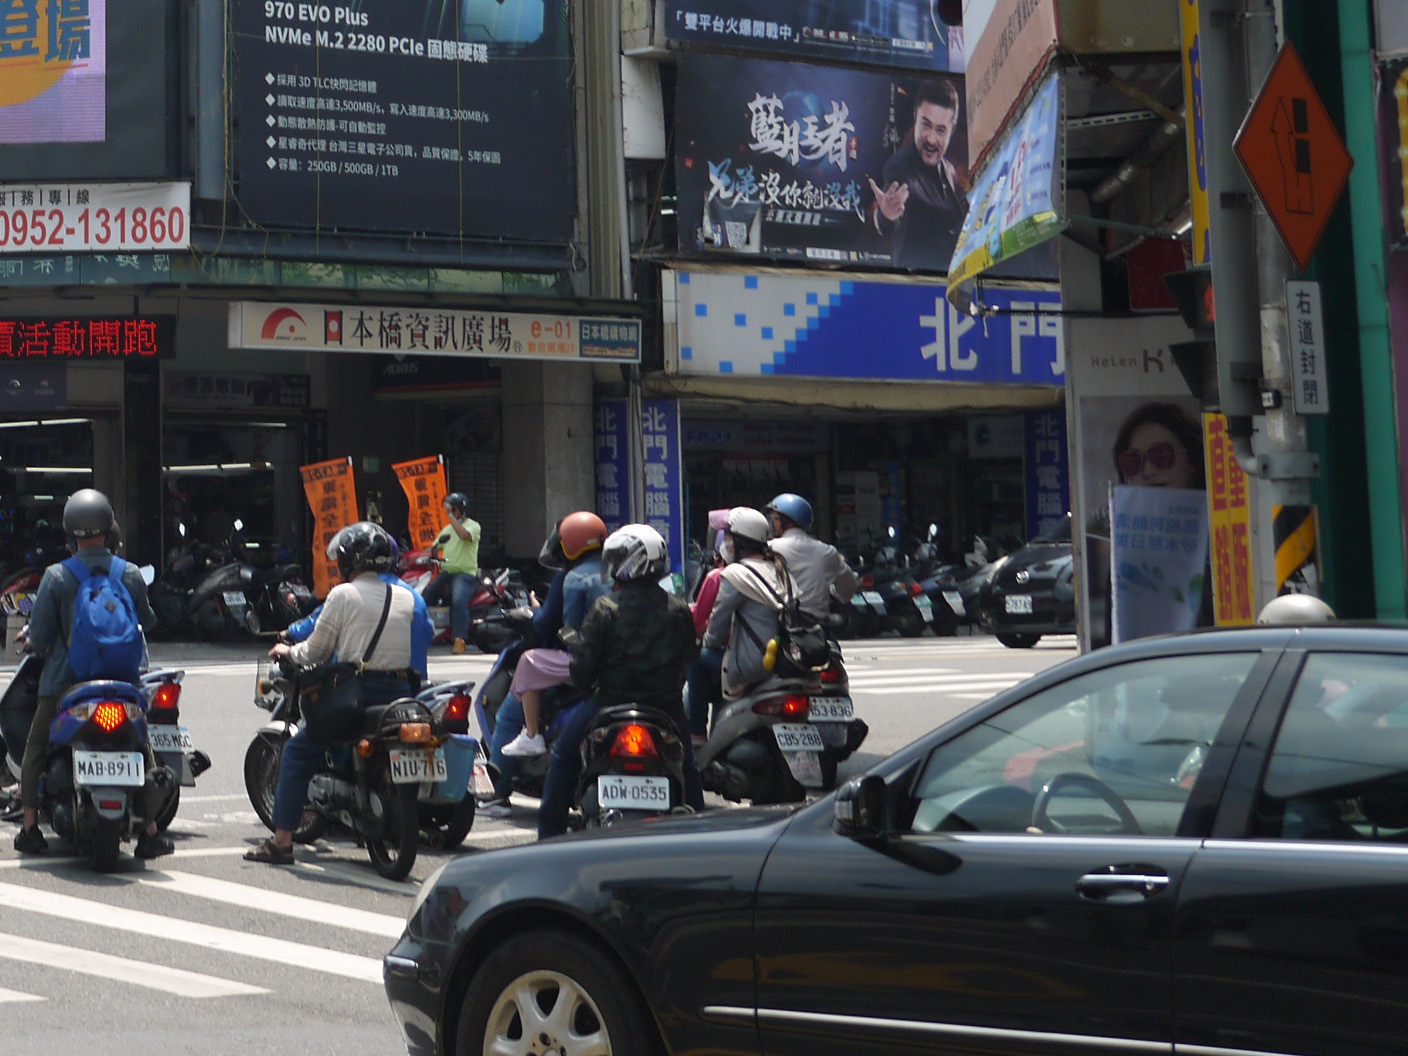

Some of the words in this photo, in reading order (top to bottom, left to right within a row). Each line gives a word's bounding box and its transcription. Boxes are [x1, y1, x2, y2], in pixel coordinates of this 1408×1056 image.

[264, 0, 295, 21] 970
[298, 4, 331, 23] EVO
[334, 7, 369, 27] Plus
[265, 25, 312, 46] NVMe
[315, 30, 344, 50] M.2
[347, 34, 386, 53] 2280
[389, 36, 424, 56] PCIe
[427, 38, 489, 64] 固態硬碟
[277, 73, 297, 88] 採用
[298, 75, 311, 88] 3D
[307, 159, 337, 174] 250GB
[344, 161, 374, 176] 500GB
[381, 164, 399, 177] 1TB
[322, 309, 513, 353] 日本橋資訊廣場
[78, 757, 142, 778] MAB-8911
[601, 783, 669, 802] ADW-0535
